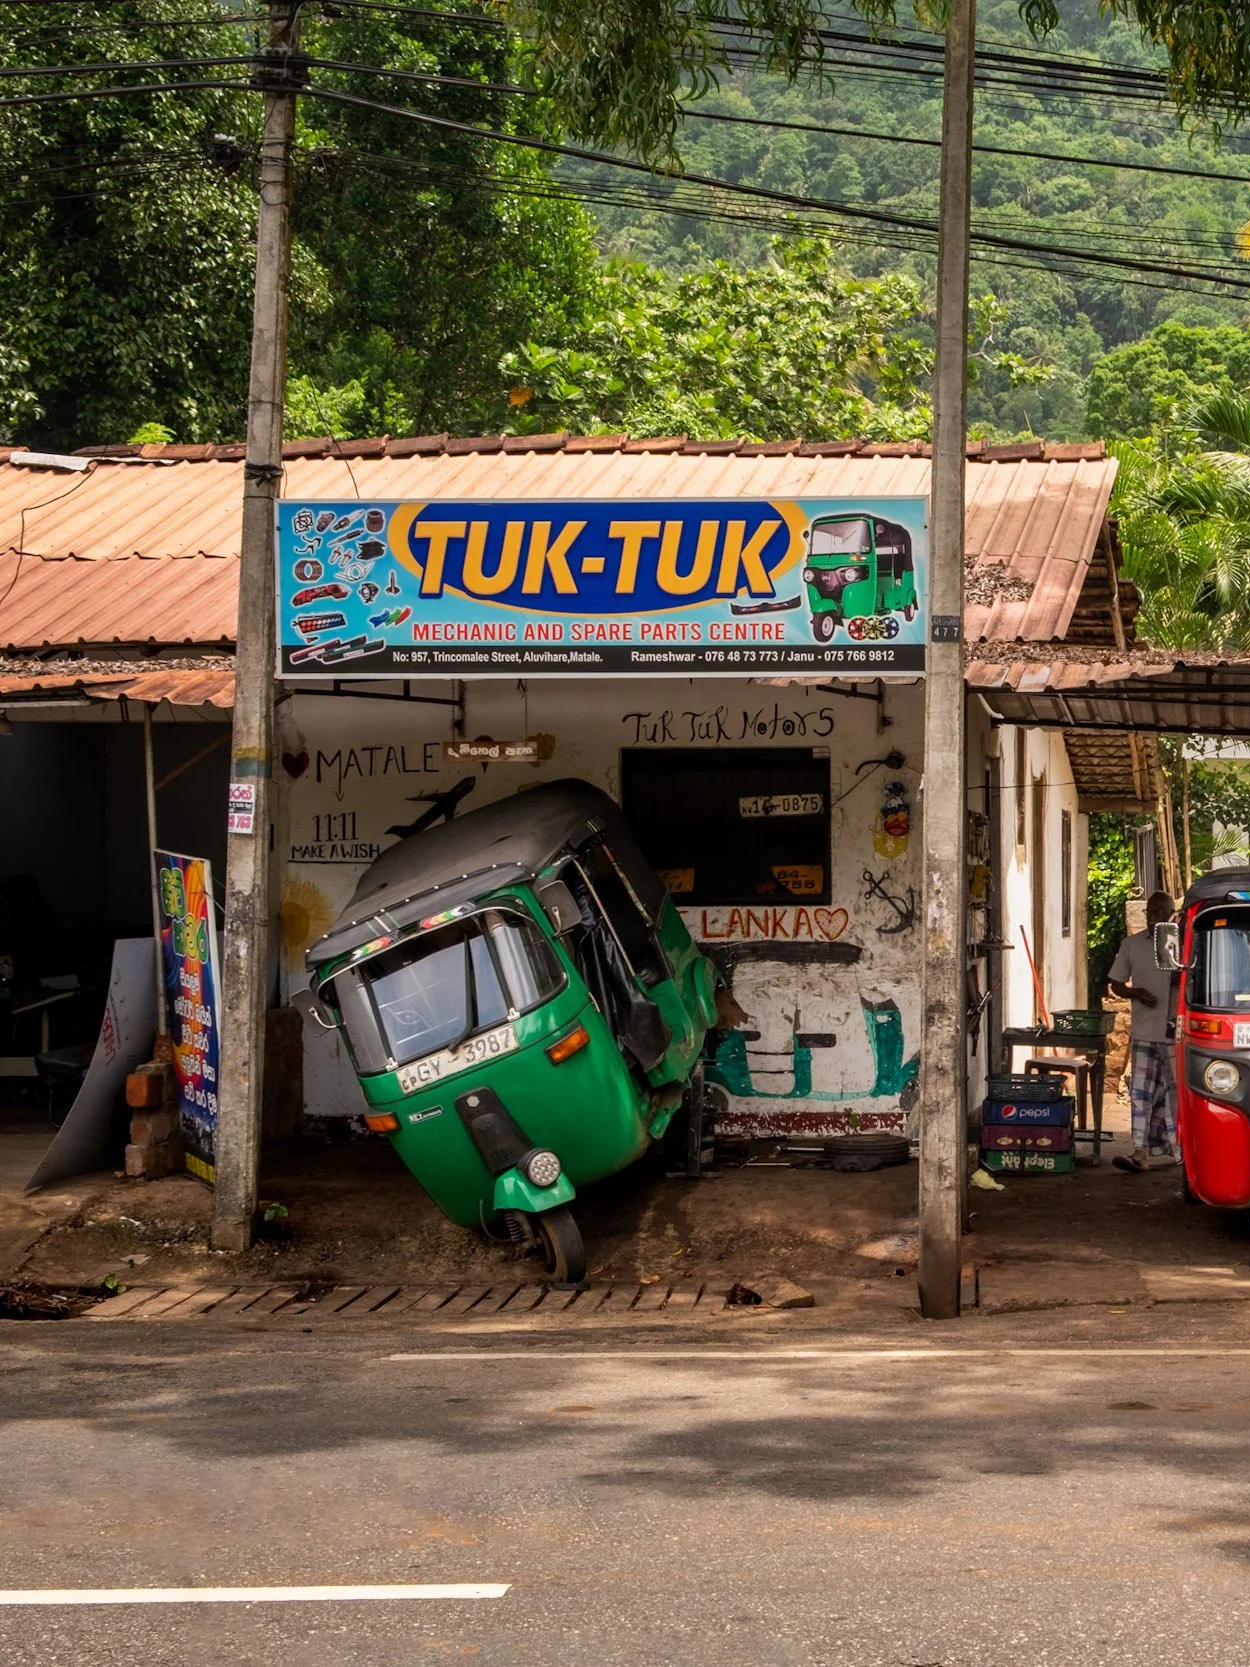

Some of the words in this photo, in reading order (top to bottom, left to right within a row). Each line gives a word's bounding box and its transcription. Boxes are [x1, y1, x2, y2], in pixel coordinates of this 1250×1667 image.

[414, 520, 783, 595] TUK-TUK
[412, 622, 516, 641] MECHANIC
[523, 623, 563, 641] AND
[571, 623, 633, 641] SPARE
[640, 623, 702, 641] PARTS
[709, 623, 785, 640] CENTRE
[393, 652, 409, 662] No:
[411, 651, 431, 663] 957,
[433, 651, 489, 662] Trincomalee
[491, 651, 521, 663] Street,
[631, 651, 696, 662] Rameshwar
[704, 651, 724, 662] 076
[727, 651, 740, 662] 48
[743, 651, 757, 662] 73
[759, 651, 778, 662] 773
[787, 651, 815, 662] Janu
[824, 650, 844, 661] 075
[847, 650, 866, 661] 766
[868, 650, 895, 661] 9812
[316, 742, 441, 783] MATALE
[312, 811, 359, 842] 11:11
[291, 844, 327, 860] MAKE
[329, 844, 339, 859] A
[339, 843, 381, 859] WISH
[701, 907, 814, 939] LANKA
[401, 1076, 417, 1091] CP
[417, 1056, 442, 1082] GY
[463, 1028, 511, 1063] 3987
[1019, 1107, 1050, 1118] pepsi
